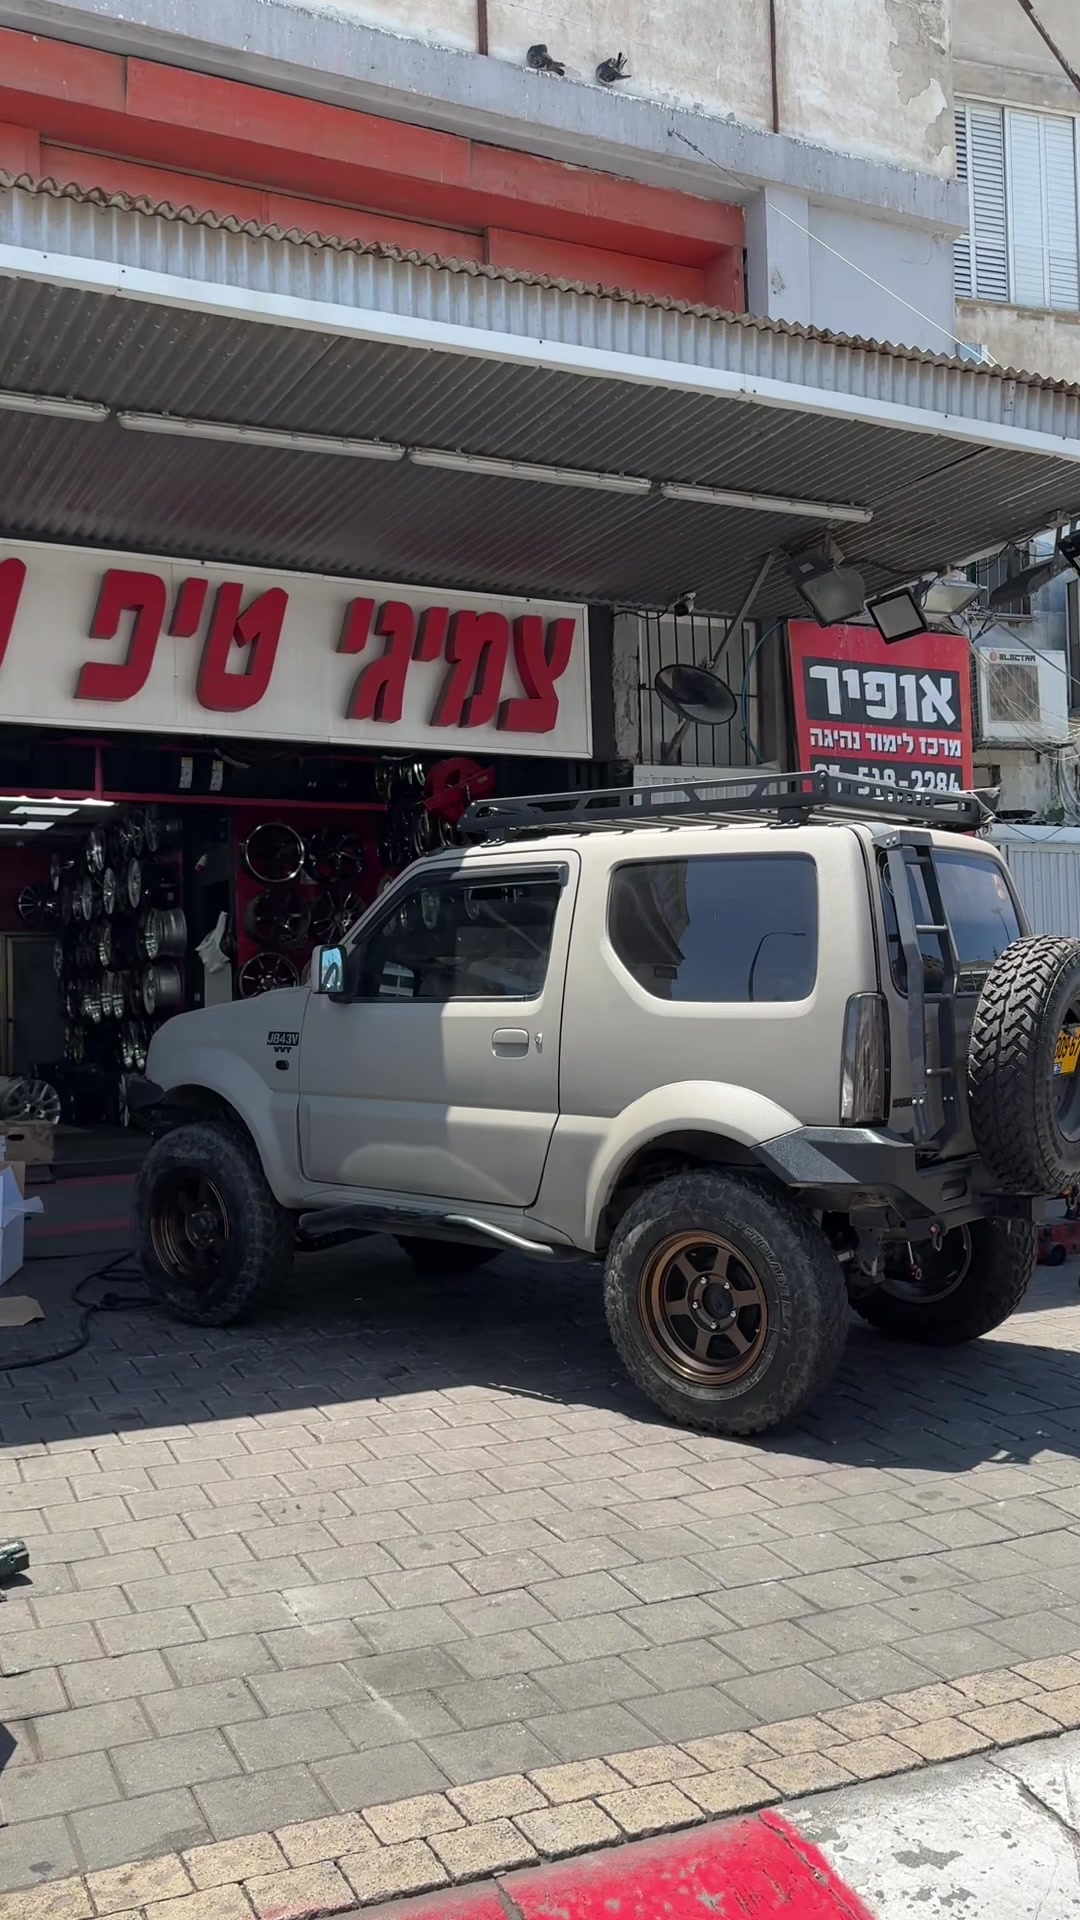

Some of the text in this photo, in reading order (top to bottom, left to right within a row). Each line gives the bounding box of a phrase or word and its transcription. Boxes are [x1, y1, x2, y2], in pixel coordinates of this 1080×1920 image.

[73, 568, 289, 712] טיפ
[999, 653, 1036, 662] ELECTRA
[336, 597, 576, 733] צמיגי
[809, 665, 956, 725] אופיר
[809, 727, 962, 757] מרכז לימוד נהיגה
[814, 763, 961, 795] 518-2284
